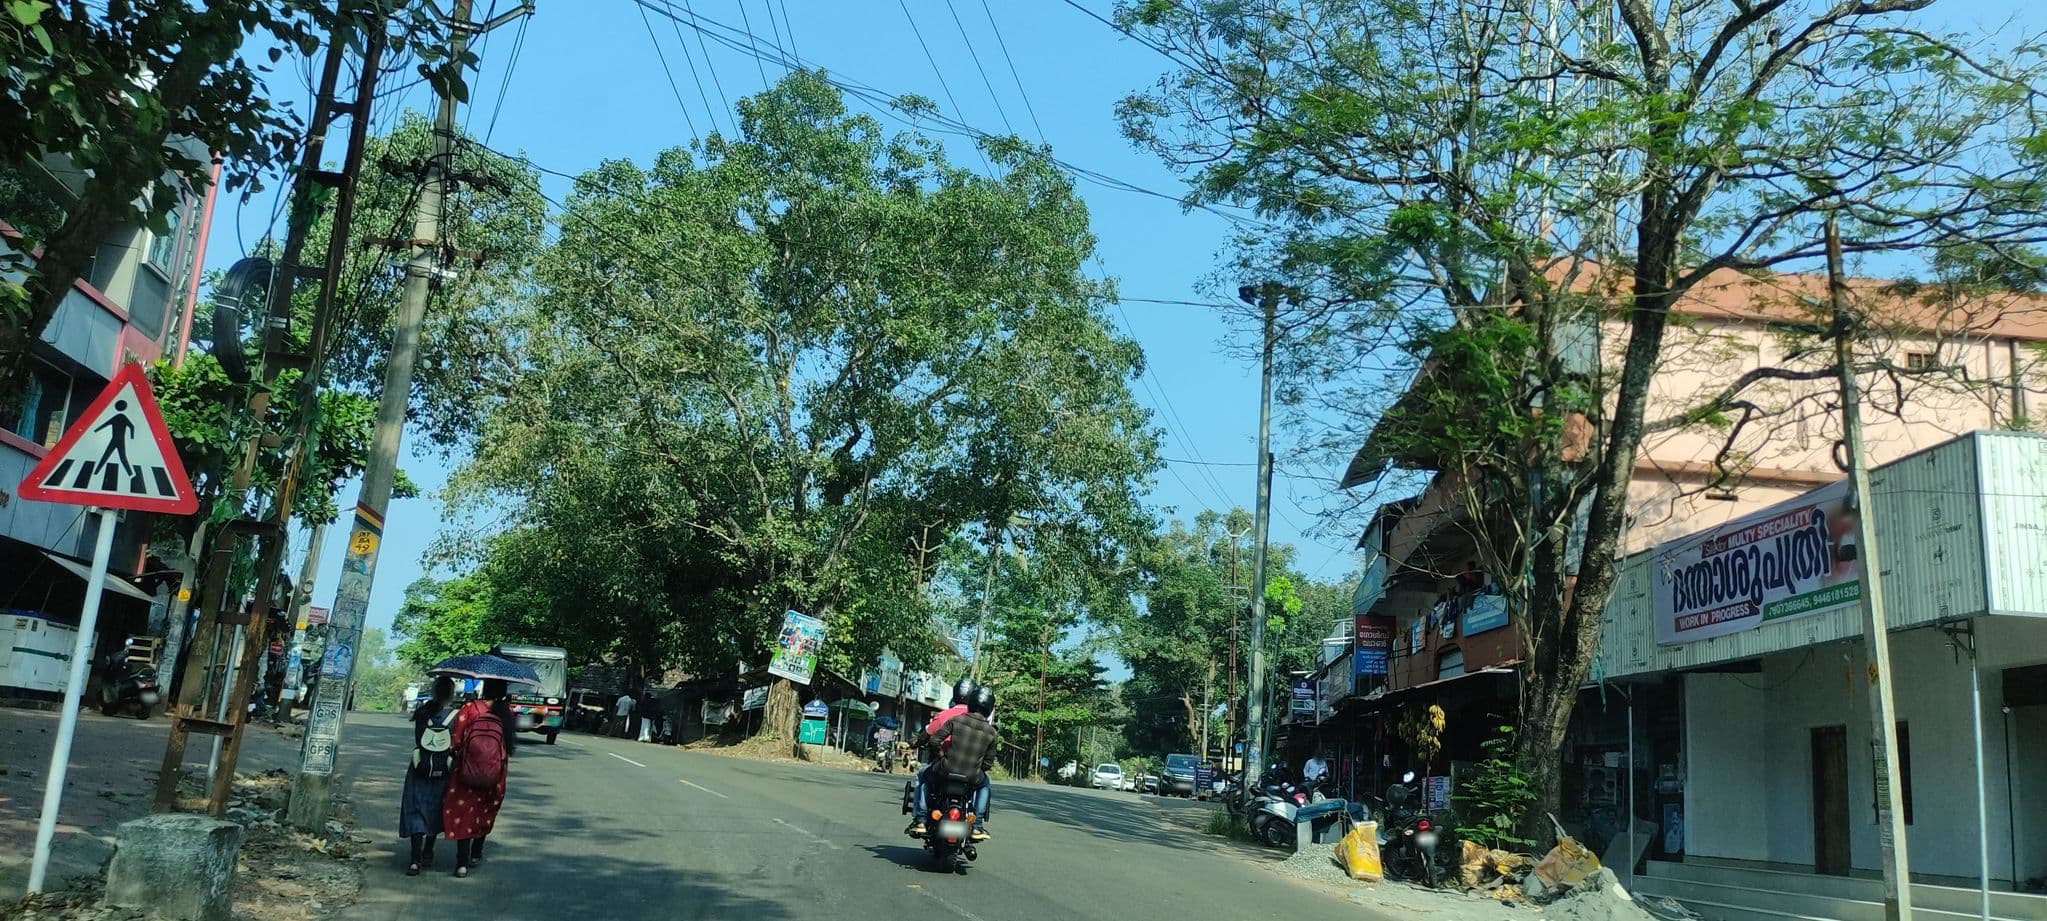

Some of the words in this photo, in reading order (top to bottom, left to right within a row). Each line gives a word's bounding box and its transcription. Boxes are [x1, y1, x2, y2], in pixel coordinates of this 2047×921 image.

[1727, 527, 1758, 547] MULTY
[1758, 509, 1813, 539] SPECIALITY
[1679, 615, 1699, 630] WORK
[1700, 613, 1709, 625] IN
[1711, 603, 1750, 622] PROGRESS
[316, 708, 337, 719] GPS
[309, 744, 331, 755] GPS
